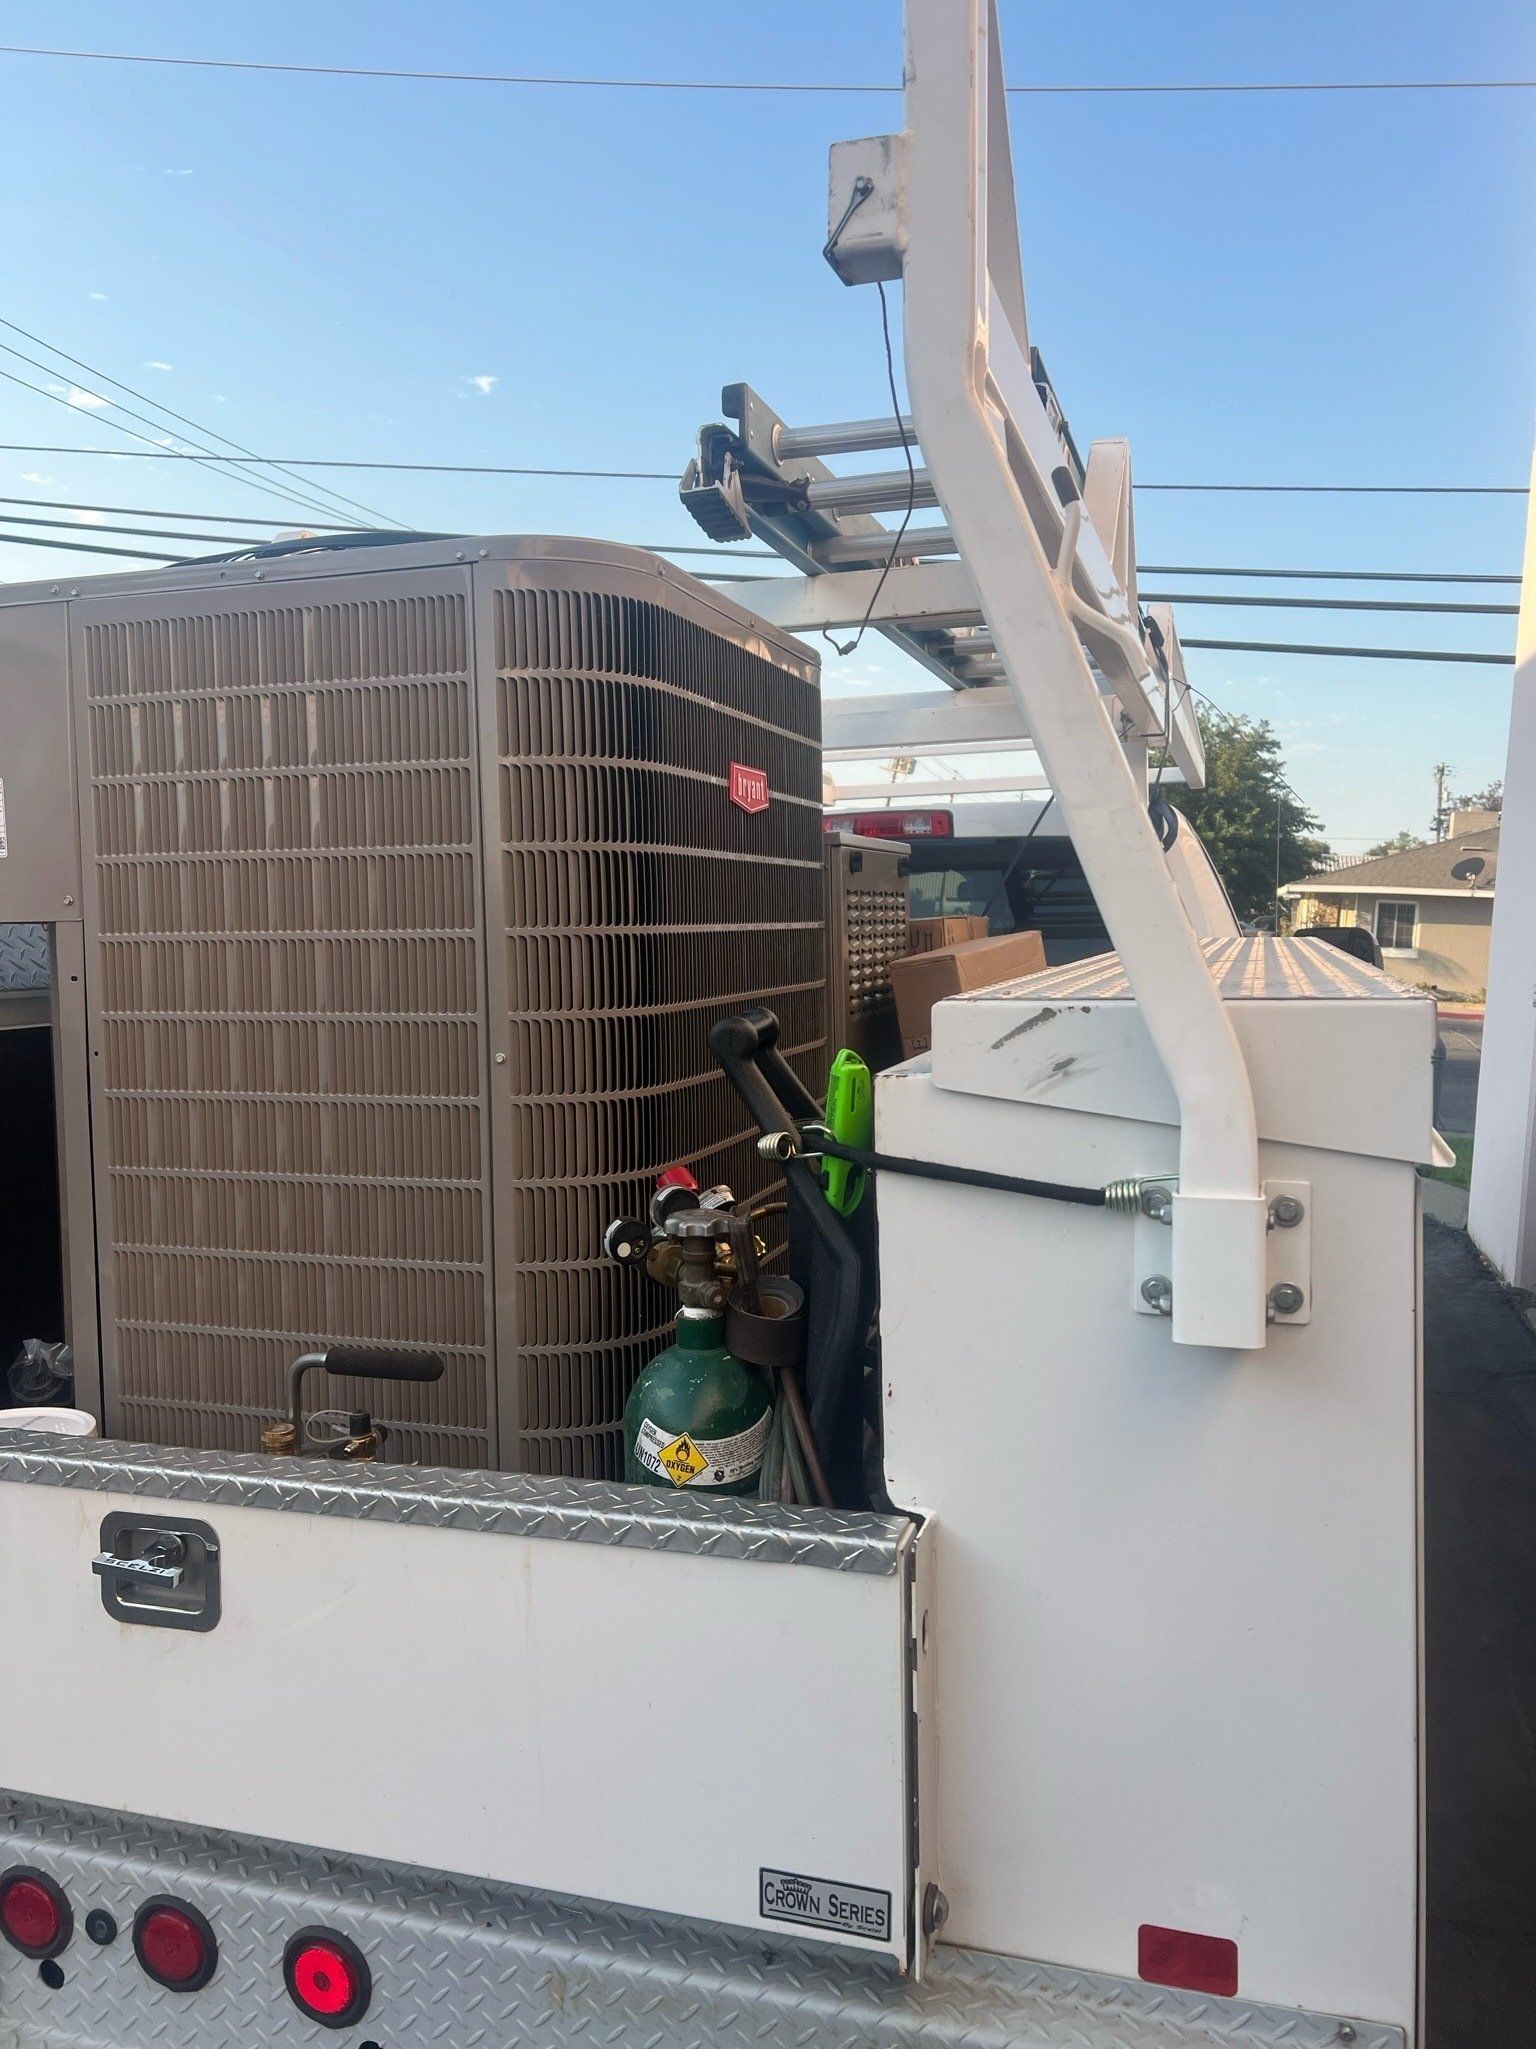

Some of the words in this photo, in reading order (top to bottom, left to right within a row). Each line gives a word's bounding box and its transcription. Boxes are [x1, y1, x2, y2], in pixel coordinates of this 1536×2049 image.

[737, 772, 765, 803] bryant
[635, 1443, 661, 1473] UN1072
[666, 1459, 696, 1474] OXYGEN
